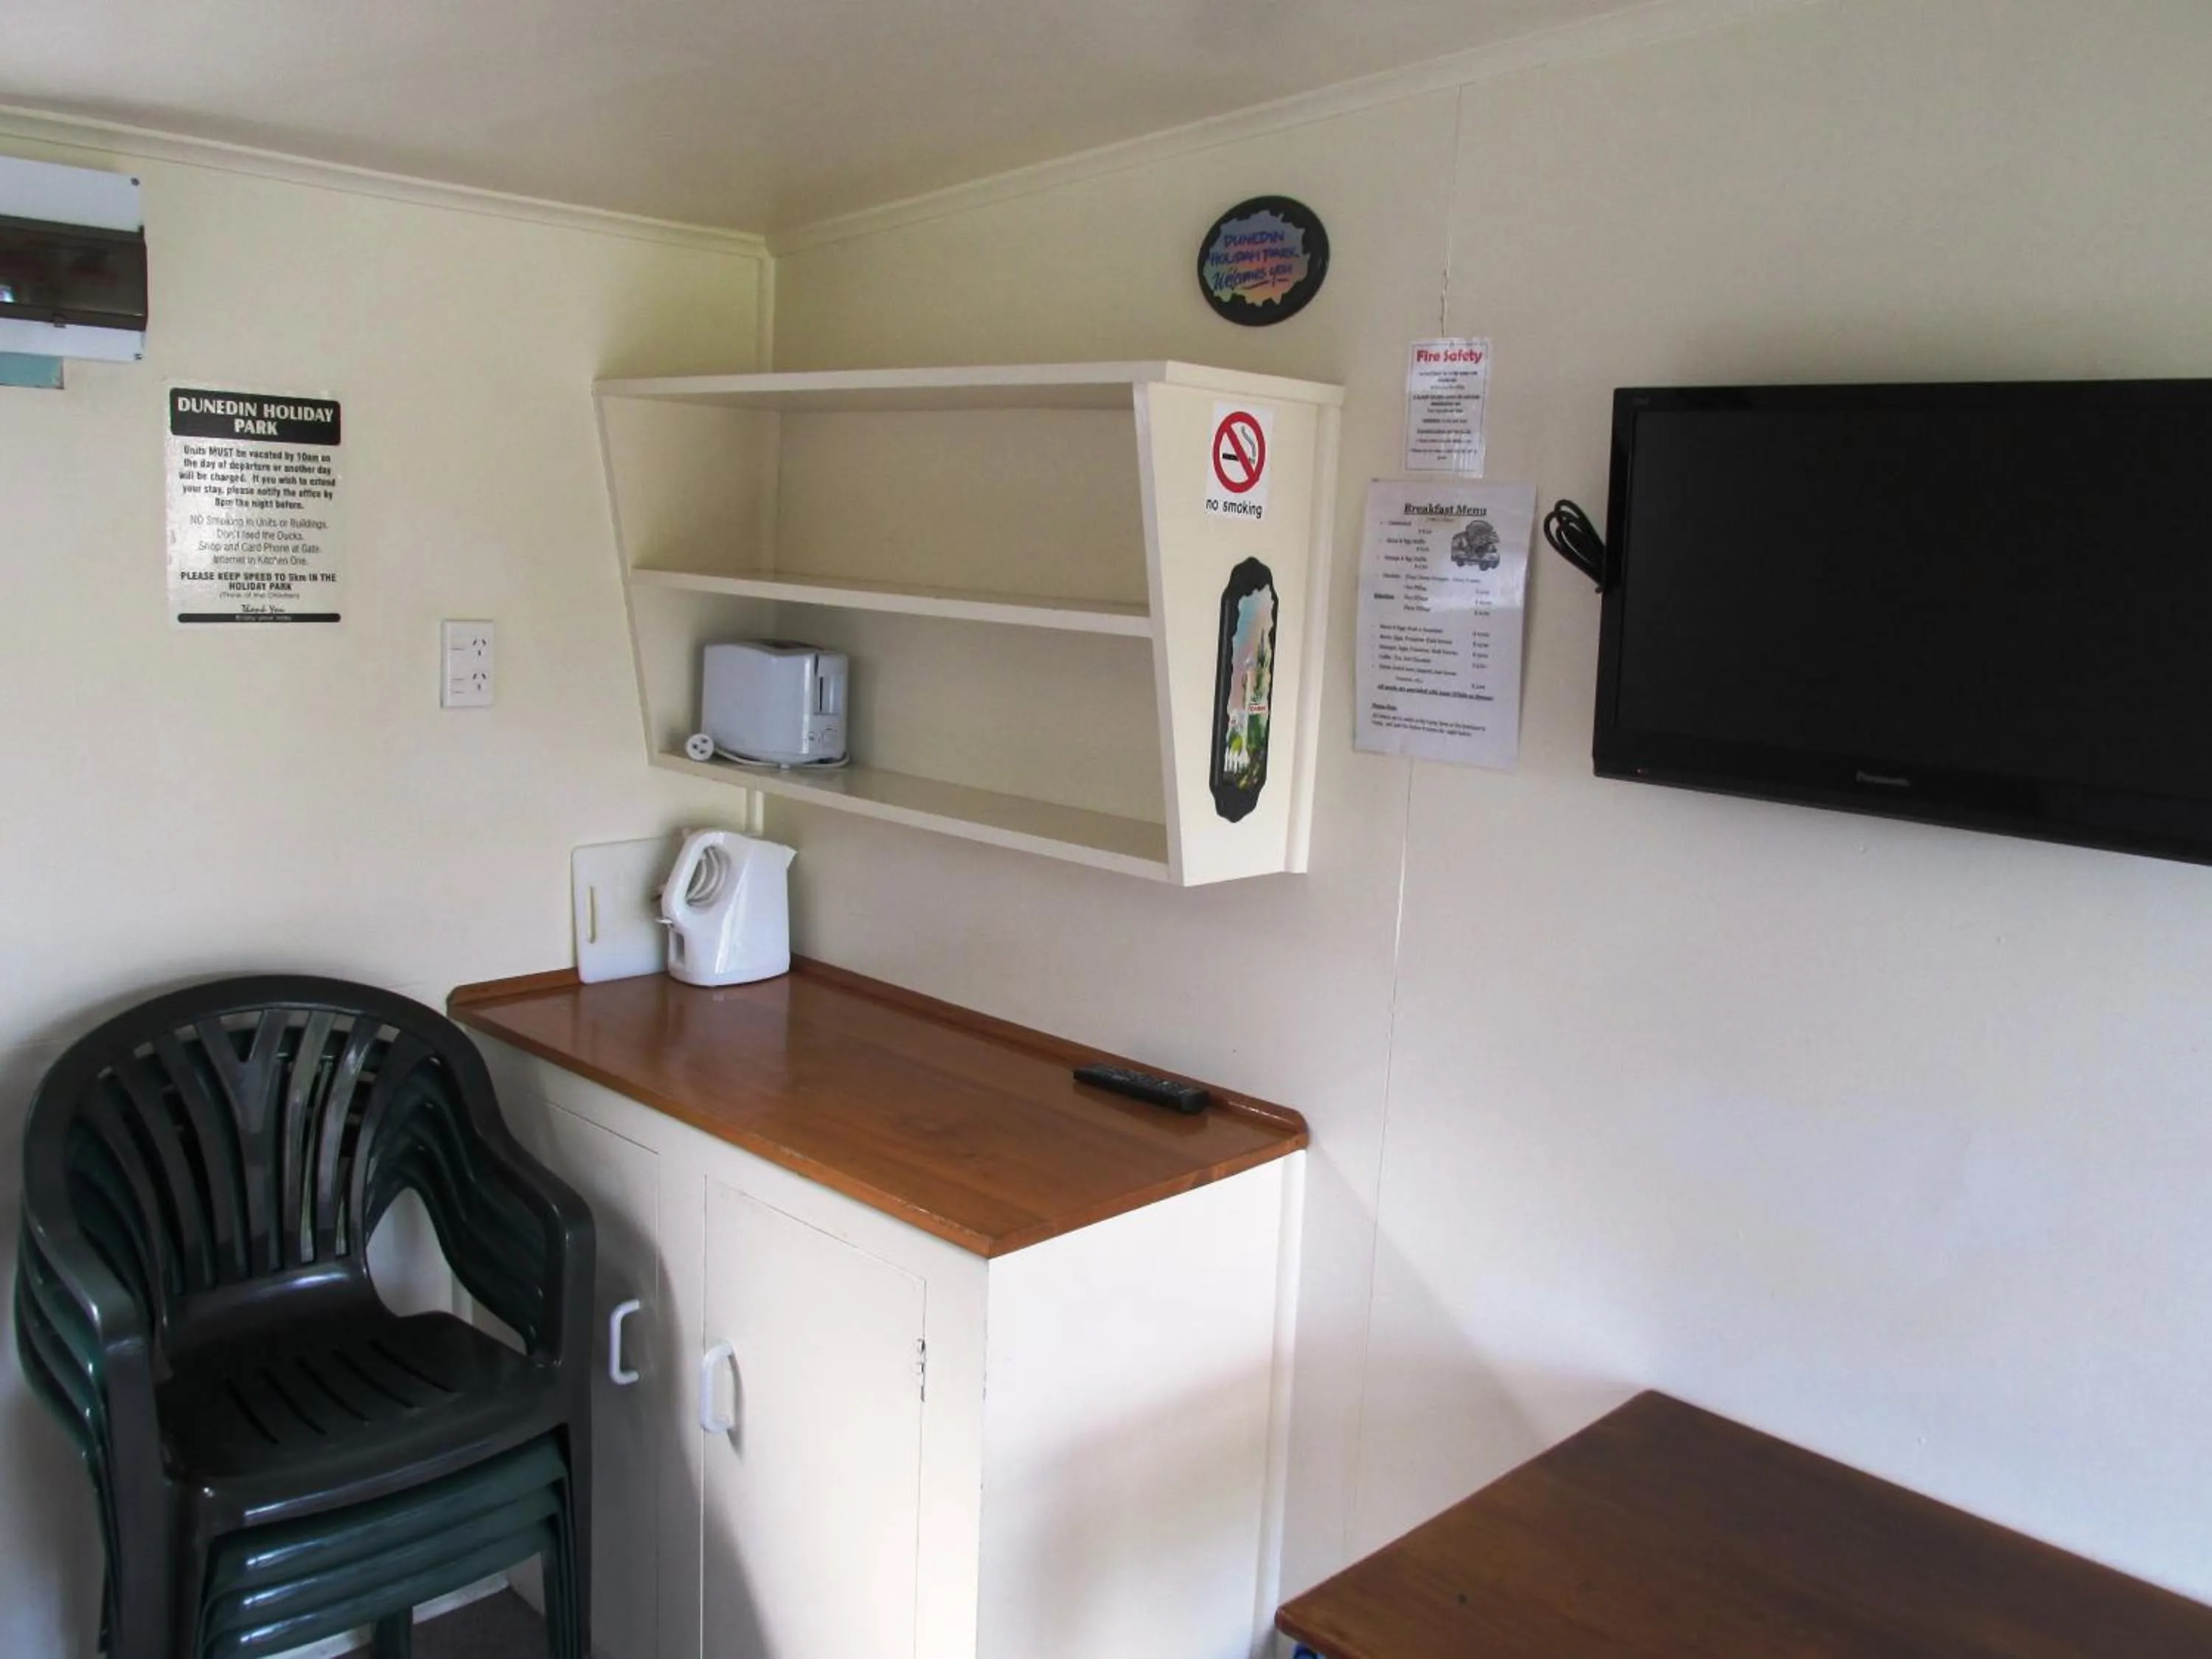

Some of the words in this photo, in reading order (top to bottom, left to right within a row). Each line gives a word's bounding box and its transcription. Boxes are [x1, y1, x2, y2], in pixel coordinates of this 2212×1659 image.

[1224, 229, 1285, 247] DUNEDIN
[1416, 350, 1440, 362] Fire
[1444, 349, 1482, 364] Safety
[178, 397, 257, 417] DUNEDIN
[264, 403, 334, 422] HOLIDAY
[234, 420, 279, 436] PARK
[184, 445, 206, 455] Units
[209, 446, 233, 457] MUST
[236, 449, 246, 457] be
[248, 451, 282, 459] vacated
[285, 451, 294, 462] by
[296, 452, 319, 461] 10am
[184, 458, 198, 467] the
[200, 459, 215, 470] day
[218, 460, 226, 468] of
[229, 461, 270, 471] departure
[285, 465, 315, 473] another
[317, 465, 331, 476] day
[178, 471, 193, 479] will
[196, 471, 206, 480] be
[262, 476, 276, 484] you
[278, 476, 297, 484] wish
[299, 477, 307, 485] to
[310, 479, 335, 487] extend
[183, 485, 201, 493] your
[226, 486, 254, 495] please
[257, 487, 280, 498] notify
[282, 488, 296, 497] the
[299, 489, 321, 498] office
[324, 489, 333, 501] by
[235, 498, 249, 507] the
[251, 500, 274, 509] night
[1206, 499, 1219, 511] no
[1222, 501, 1262, 519] smoking
[1403, 502, 1453, 516] Breakfast
[1456, 505, 1487, 516] Menu
[189, 514, 204, 525] NO
[256, 518, 277, 528] Units
[262, 531, 275, 540] the
[223, 542, 239, 552] and
[263, 542, 290, 553] Phone
[181, 571, 215, 580] PLEASE
[218, 571, 240, 580] KEEP
[243, 573, 272, 582] SPEED
[274, 573, 286, 582] TO
[288, 573, 307, 582] 5km
[309, 574, 318, 582] IN
[320, 574, 337, 582] THE
[229, 582, 266, 590] HOLIDAY
[269, 582, 292, 591] PARK
